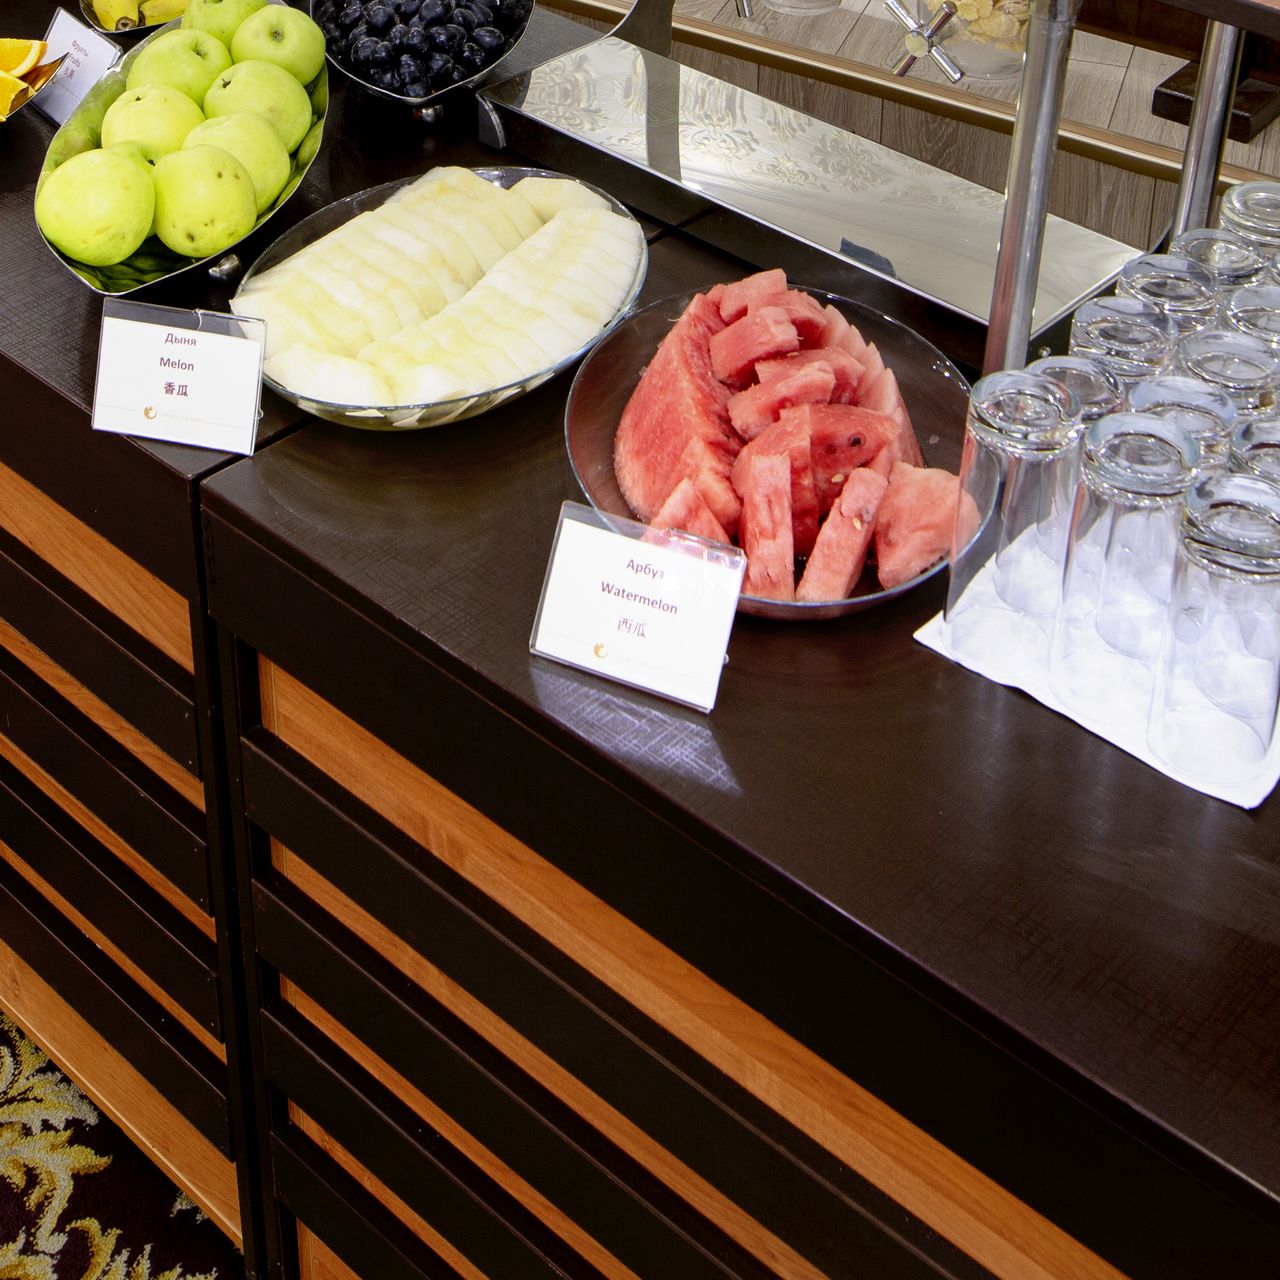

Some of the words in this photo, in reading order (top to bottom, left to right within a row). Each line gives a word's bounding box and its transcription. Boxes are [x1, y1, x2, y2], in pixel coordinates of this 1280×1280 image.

[164, 332, 197, 347] Дыня
[159, 356, 194, 371] Melon
[626, 559, 665, 579] Арбуз
[601, 581, 678, 615] Watermelon
